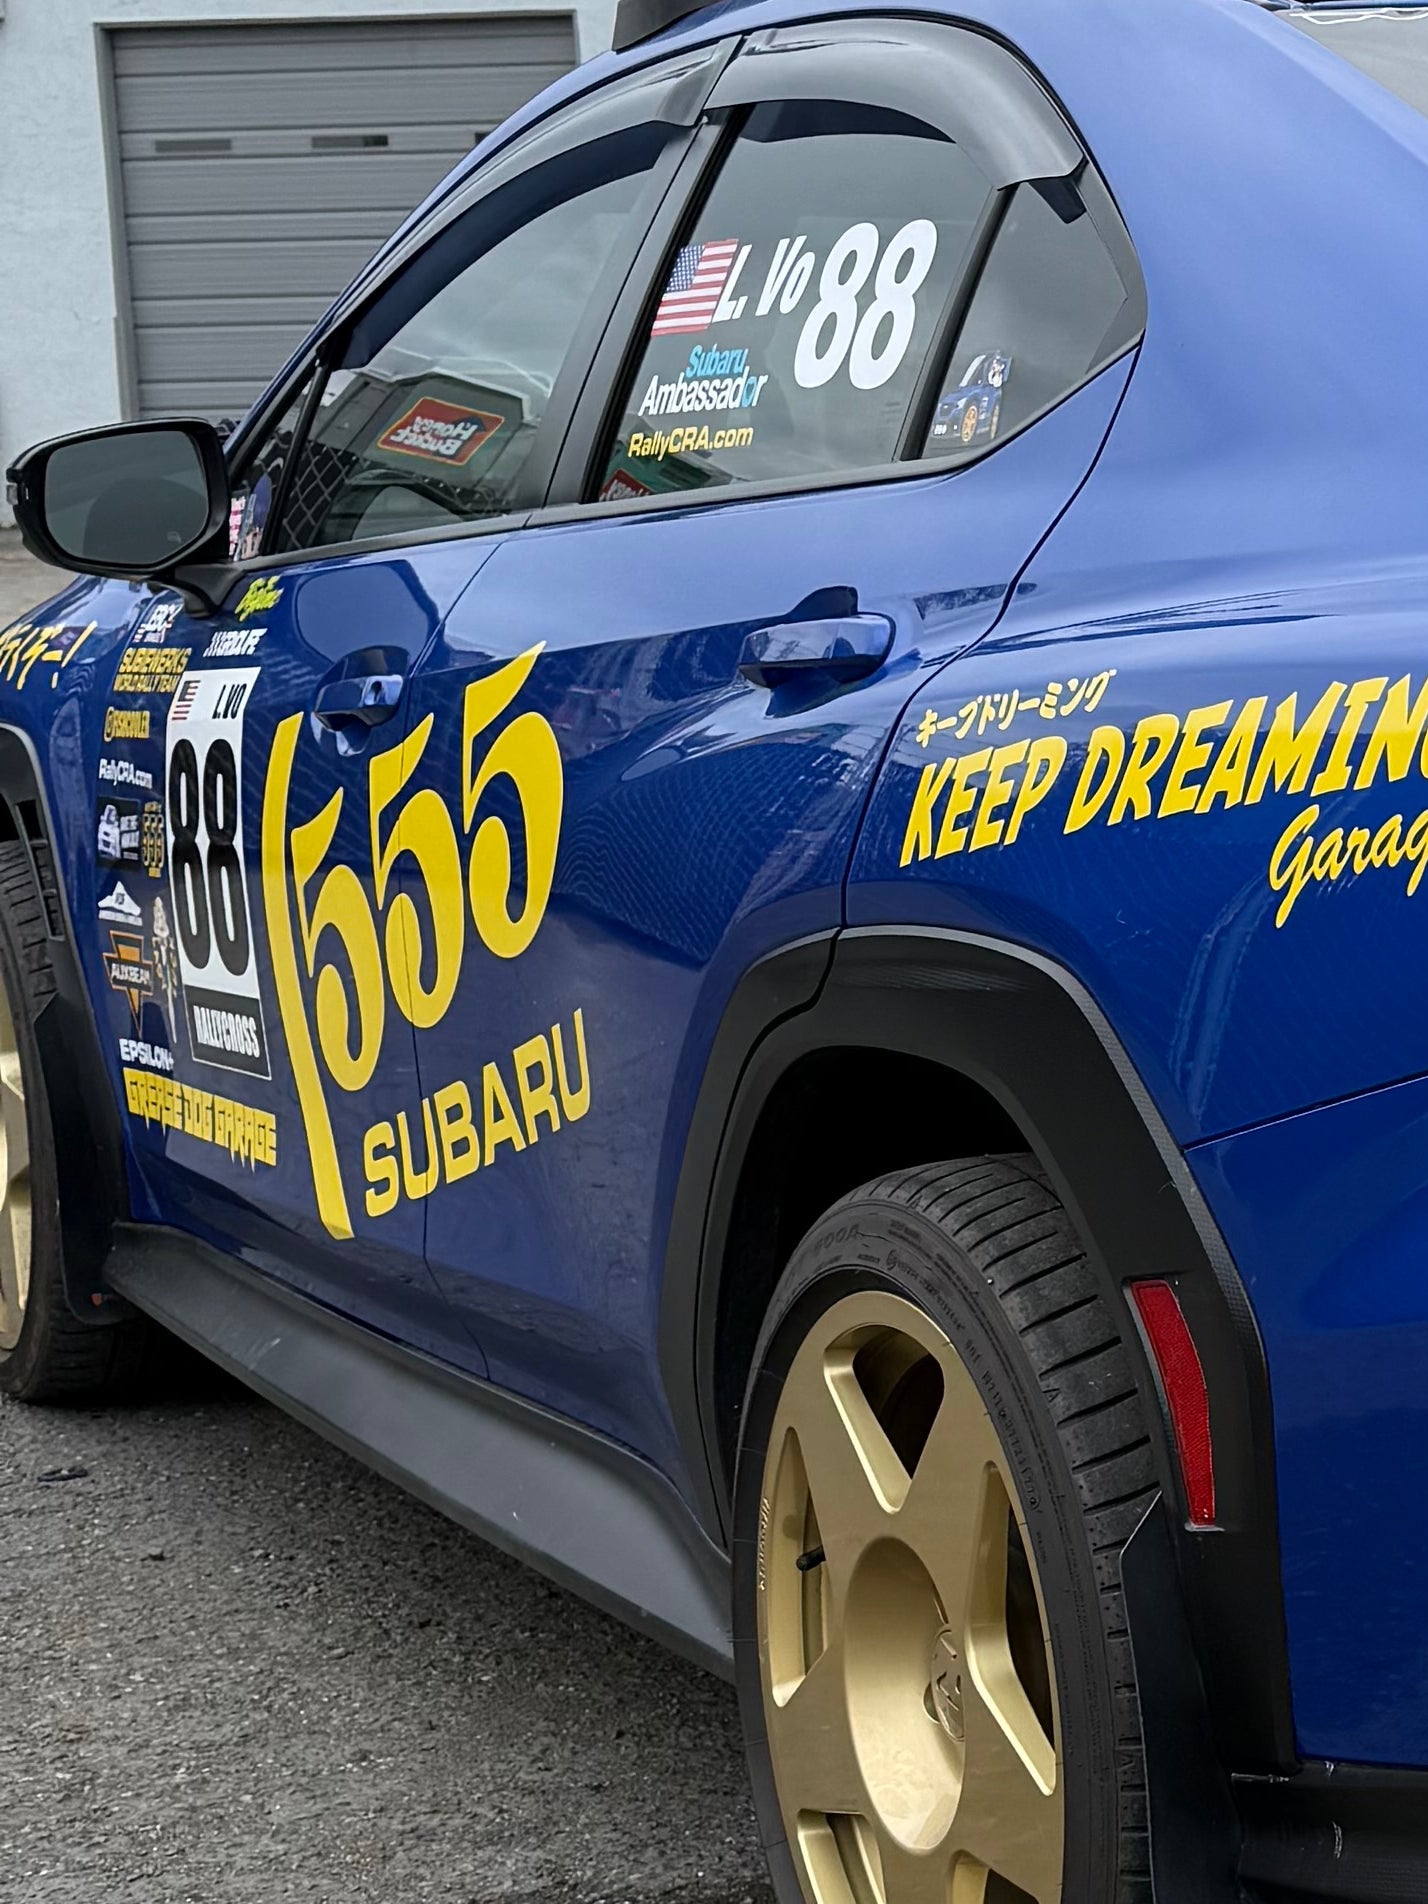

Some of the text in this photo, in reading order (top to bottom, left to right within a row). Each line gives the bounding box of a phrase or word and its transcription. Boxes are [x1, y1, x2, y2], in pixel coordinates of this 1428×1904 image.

[711, 234, 816, 324] L. Vo
[794, 218, 938, 390] 88
[637, 366, 769, 417] Ambassador
[685, 344, 749, 379] Subaru
[628, 425, 754, 461] RallyCRA.com
[99, 758, 152, 789] RallyCRA.com
[899, 736, 1067, 867] KEEP
[169, 738, 250, 976] 88
[287, 641, 564, 1094] 555
[119, 1038, 174, 1071] EPSILON+
[193, 1005, 261, 1058] RALLYCROSS
[214, 1095, 277, 1174] GARAGE
[364, 1008, 591, 1217] SUBARU
